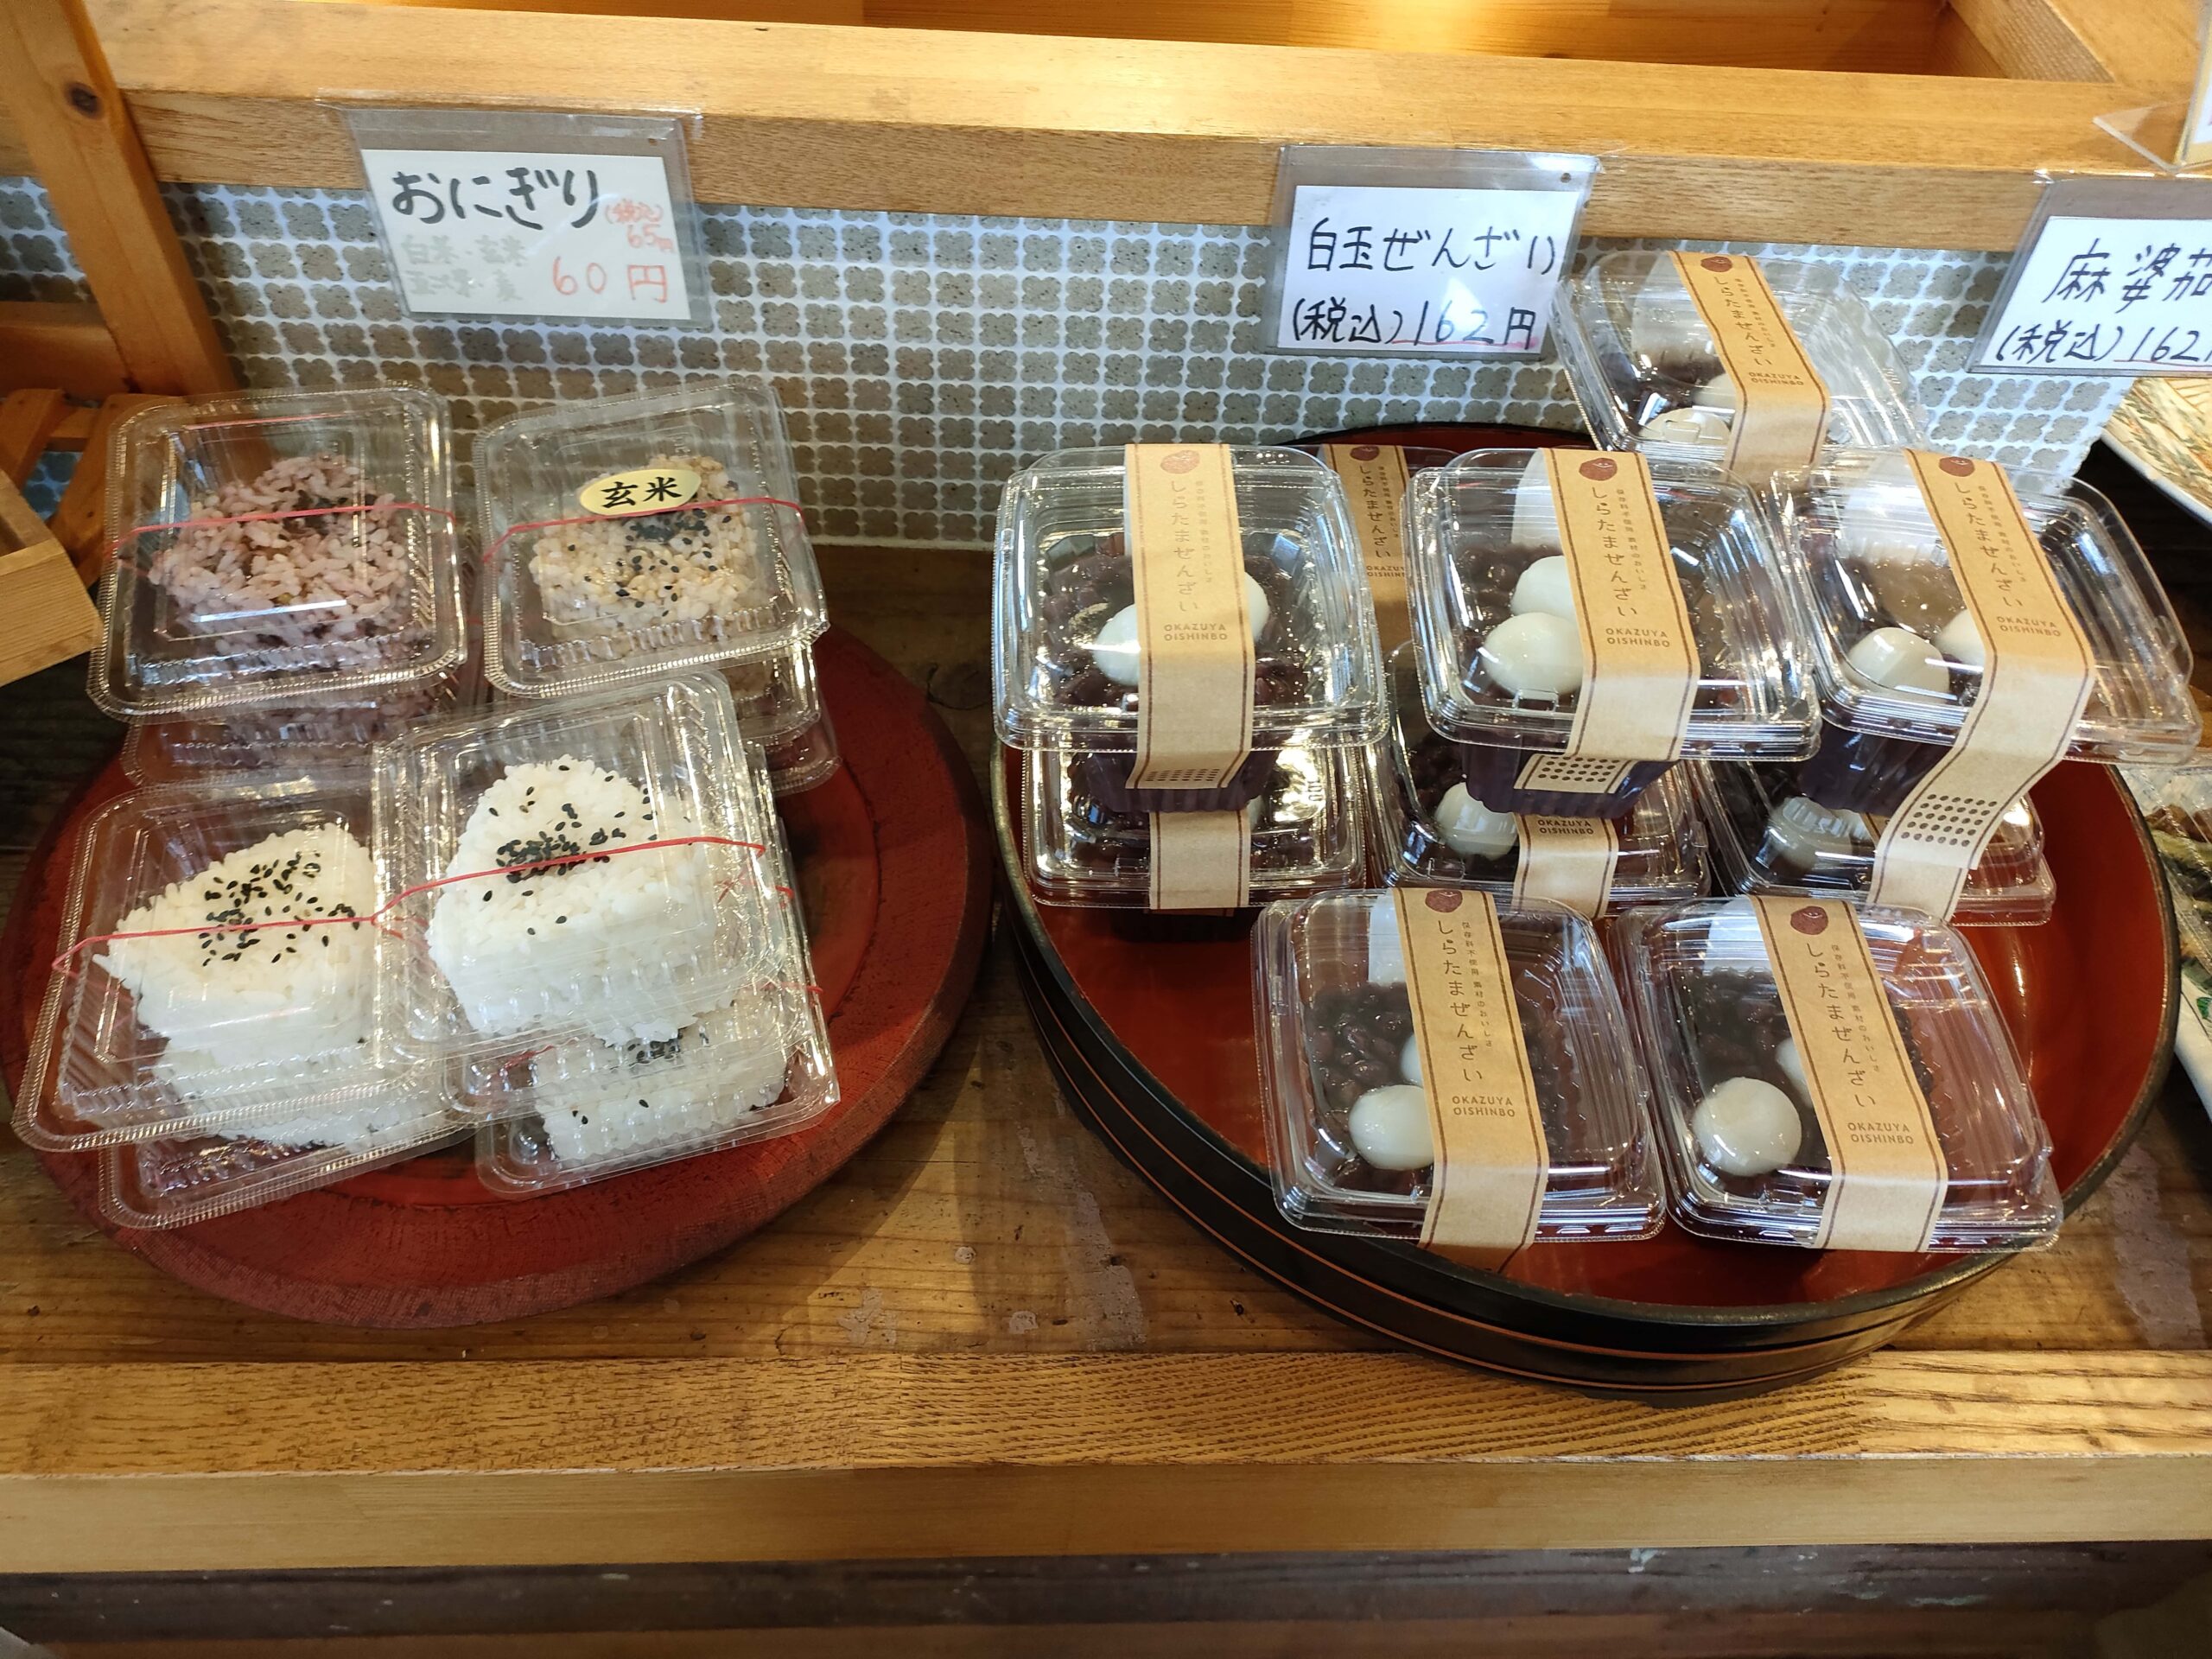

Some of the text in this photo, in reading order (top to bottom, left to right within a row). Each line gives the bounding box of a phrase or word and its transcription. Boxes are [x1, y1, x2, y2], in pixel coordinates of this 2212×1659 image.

[391, 167, 599, 230] おにぎり
[1995, 320, 2212, 365] (税込)162
[1164, 622, 1227, 632] OKAZUYA
[1605, 626, 1669, 639] OKAZUYA
[1164, 632, 1229, 642] OISHINBO
[1606, 637, 1671, 648] OISHINBO
[1537, 818, 1592, 828] OKAZUYA
[1539, 827, 1594, 836] OISHINBO
[1438, 919, 1483, 1083] しらたまぜんざい
[1807, 942, 1877, 1108] しらたまぜんざい
[1452, 1095, 1514, 1106] OKAZUYA
[1453, 1106, 1516, 1118] OISHINBO
[1847, 1122, 1910, 1134] OKAZUYA
[1850, 1133, 1915, 1145] OISHINBO
